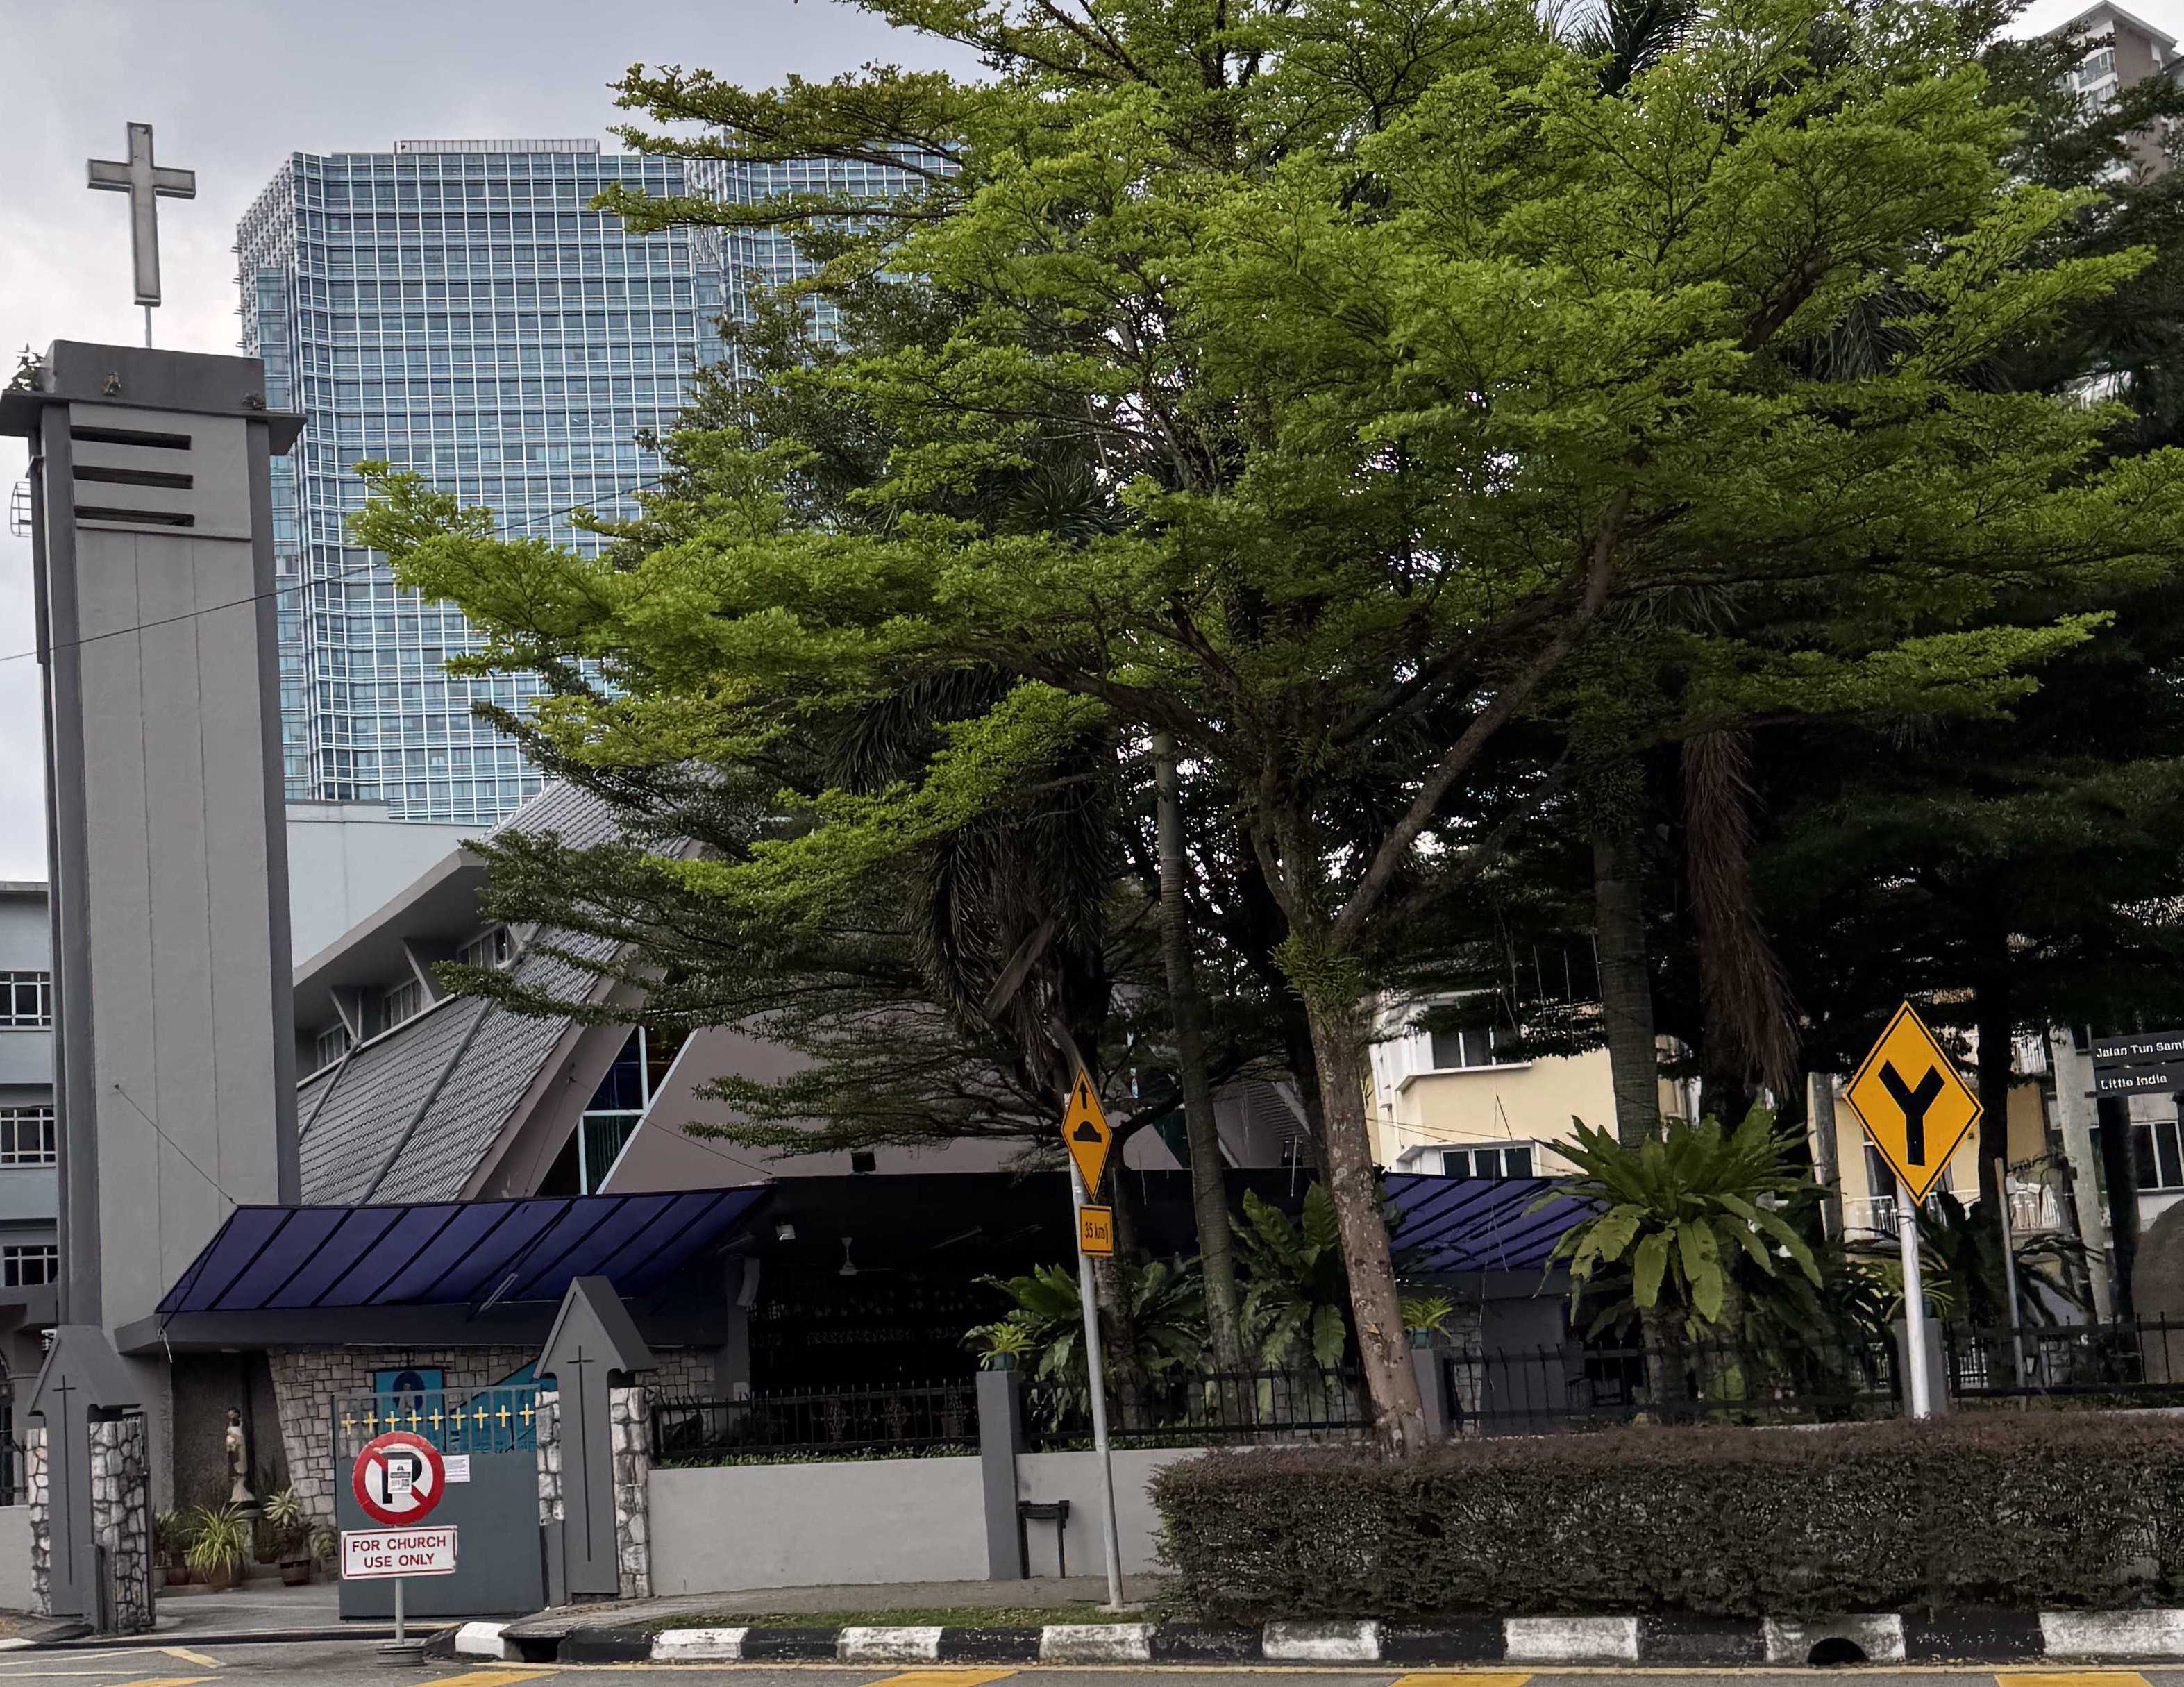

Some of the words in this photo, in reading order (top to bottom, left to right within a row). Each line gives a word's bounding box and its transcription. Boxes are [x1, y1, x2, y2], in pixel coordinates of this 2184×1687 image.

[2097, 1047, 2127, 1058] Jalan
[2130, 1044, 2153, 1055] Tun
[2101, 1077, 2133, 1090] Little
[2136, 1073, 2167, 1086] India
[1085, 1221, 1093, 1239] 35
[352, 1540, 380, 1552] FOR
[387, 1536, 446, 1550] CHURCH
[364, 1556, 393, 1568] USE
[398, 1553, 435, 1566] ONLY
